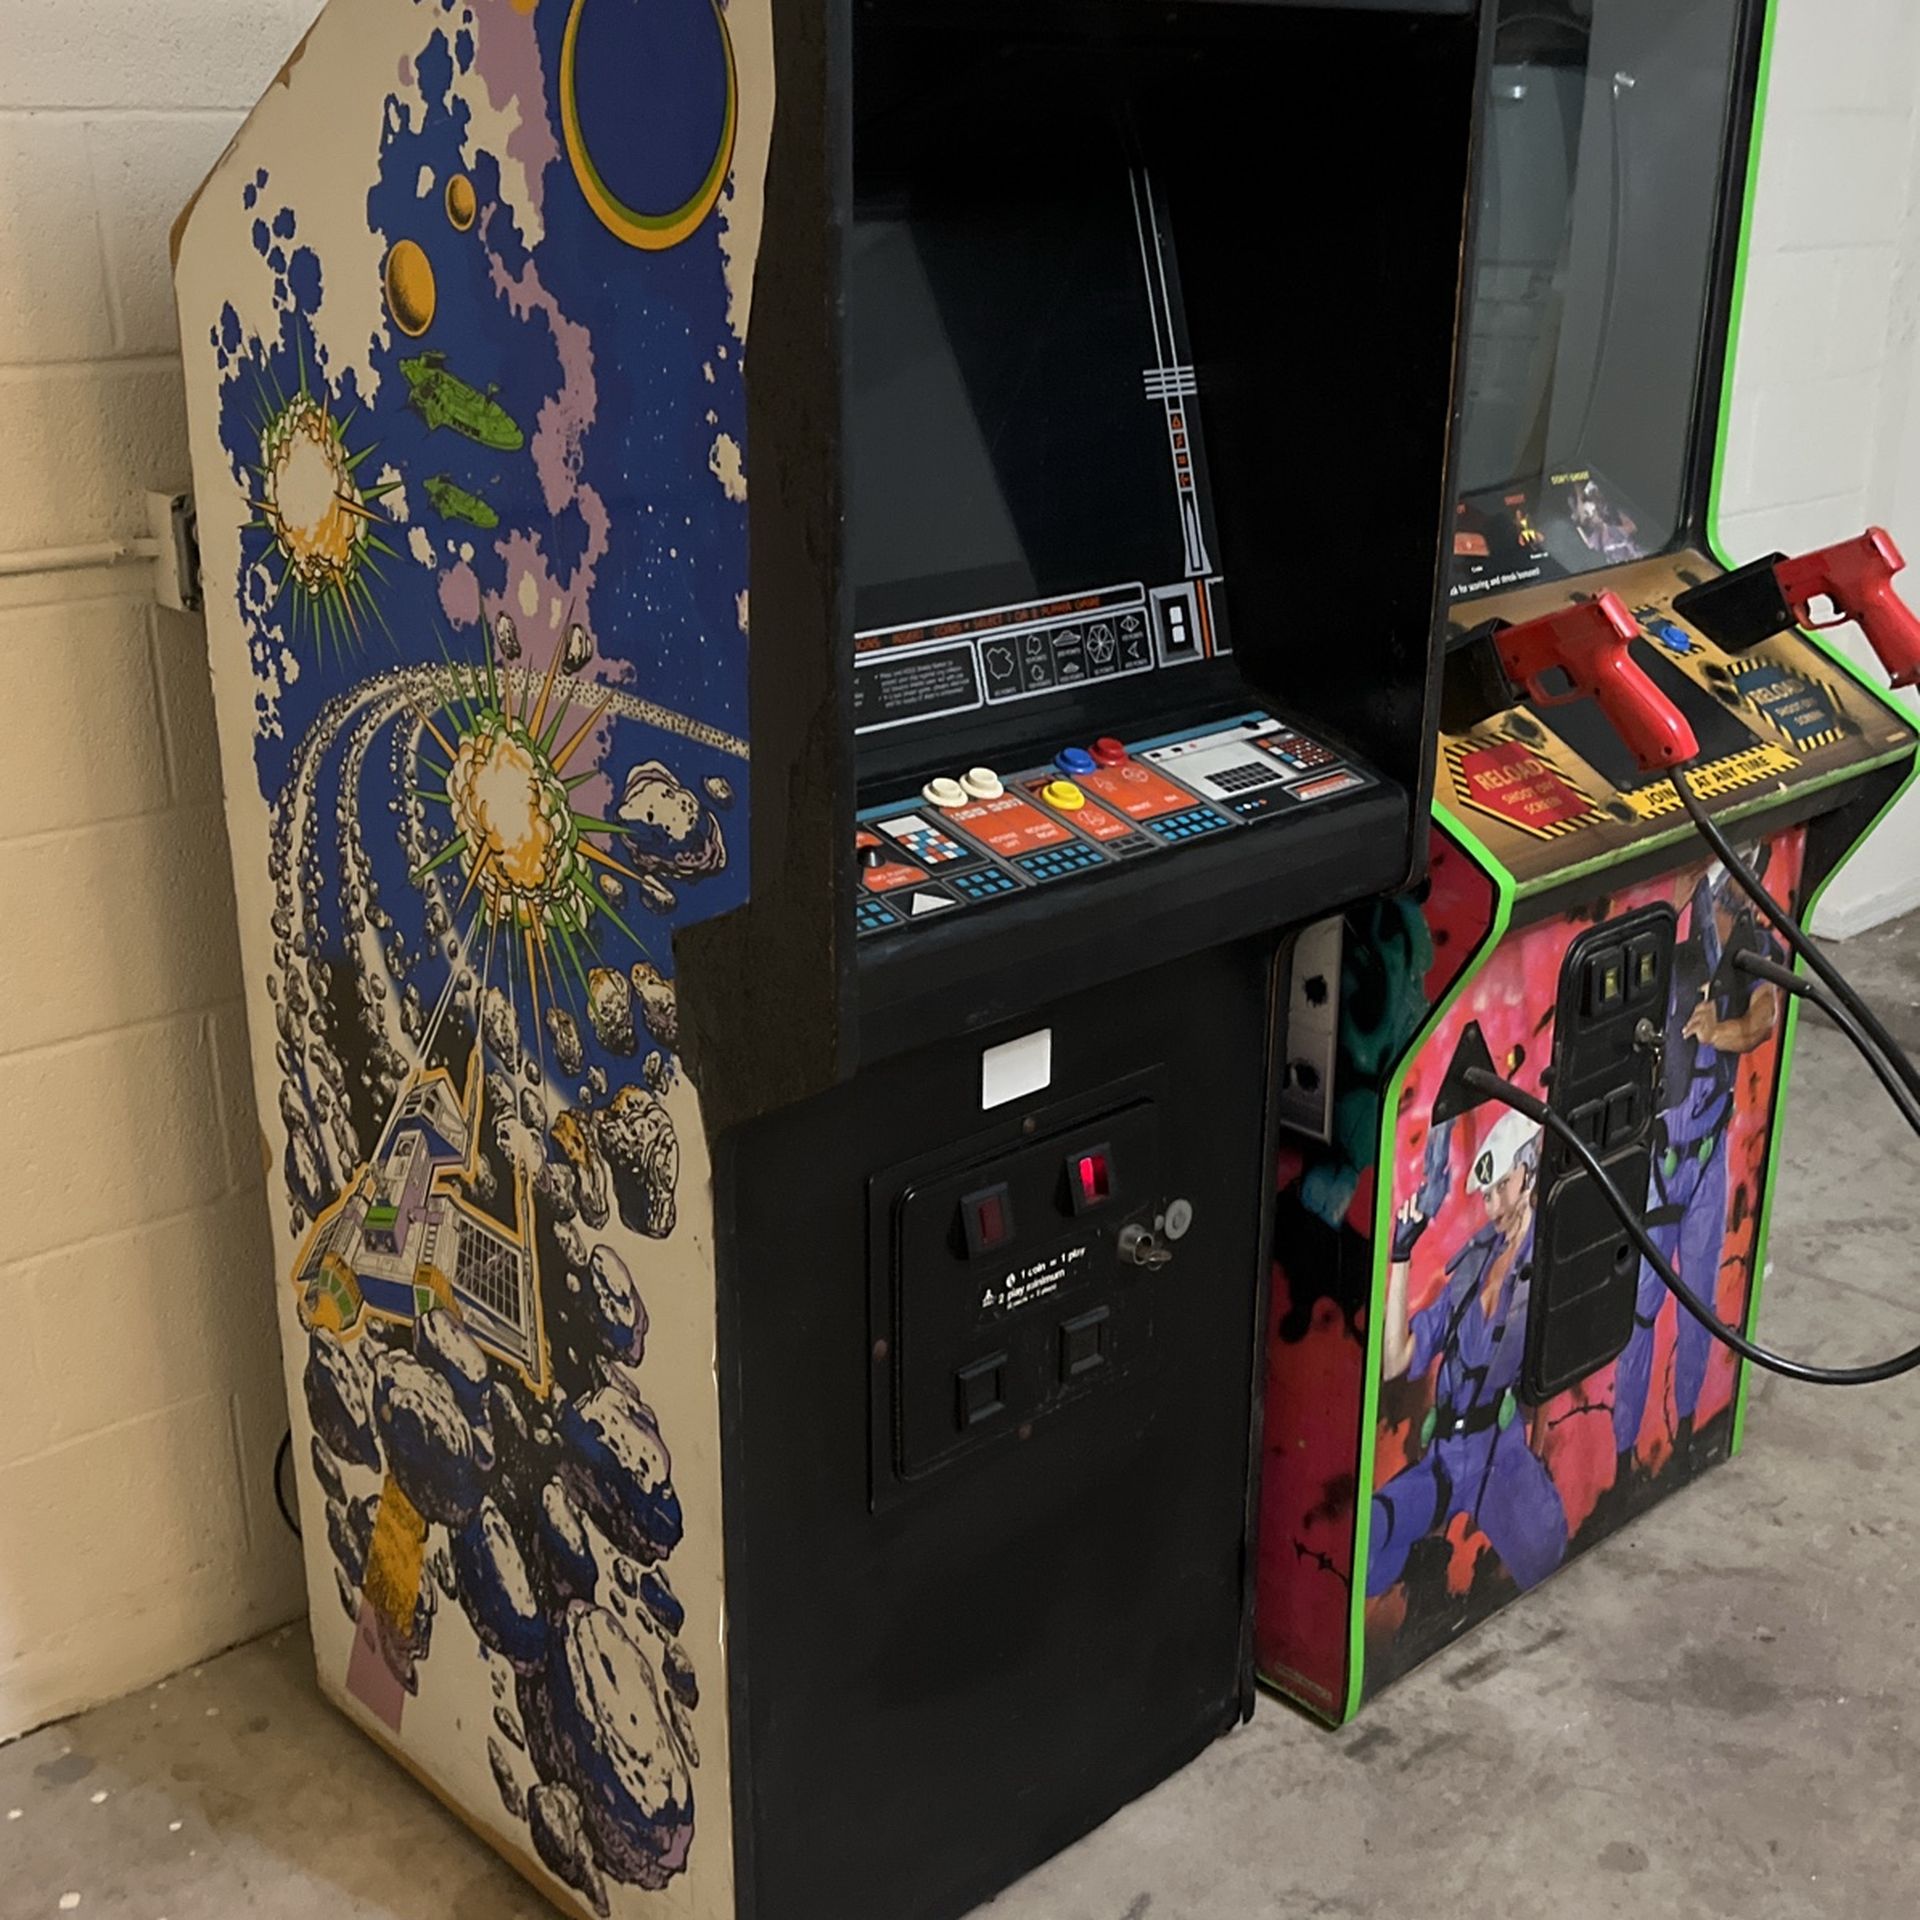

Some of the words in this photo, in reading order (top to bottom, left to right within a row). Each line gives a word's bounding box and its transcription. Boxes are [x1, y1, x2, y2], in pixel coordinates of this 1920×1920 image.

[1747, 679, 1805, 704] RELOAD
[1473, 760, 1544, 791] RELOAD
[1645, 787, 1677, 806] JOIN
[1694, 776, 1710, 789] AT
[1712, 766, 1738, 783] ANY
[1738, 756, 1771, 774] TIME
[1502, 787, 1535, 804] SHOOT
